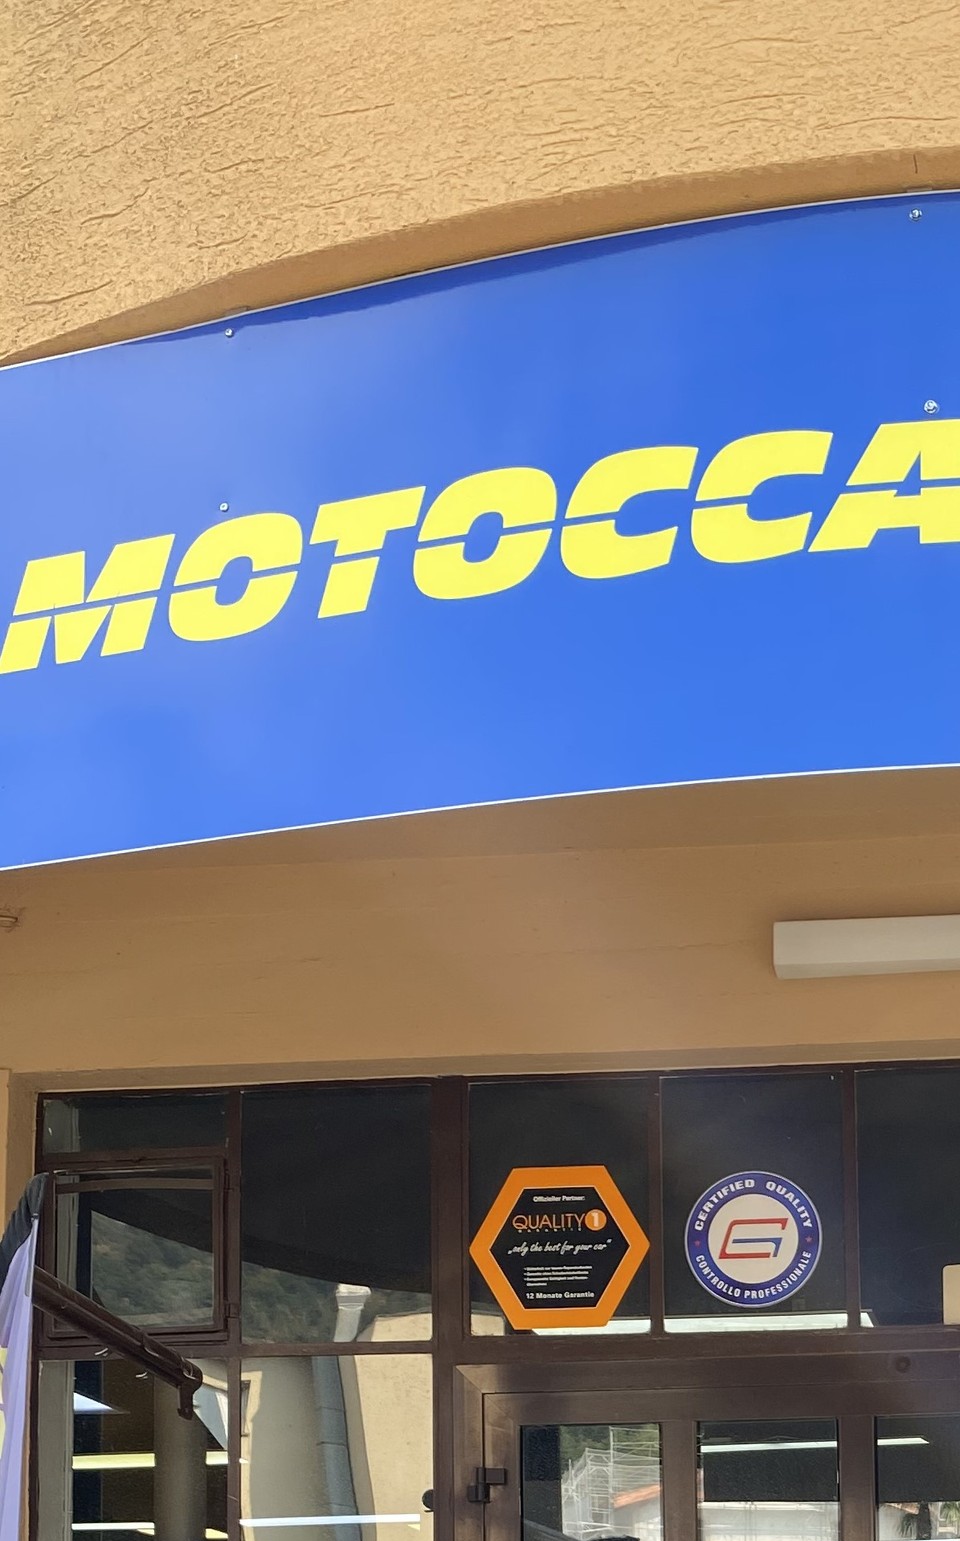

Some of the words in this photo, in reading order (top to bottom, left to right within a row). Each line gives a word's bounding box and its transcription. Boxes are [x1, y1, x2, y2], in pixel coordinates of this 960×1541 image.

[694, 1179, 756, 1231] CERTIFIED
[765, 1181, 813, 1228] QUALITY
[512, 1213, 585, 1230] QUALITY
[530, 1242, 543, 1252] the
[543, 1242, 561, 1252] best
[695, 1255, 741, 1298] CONTROLLO
[744, 1250, 812, 1299] PROFESSIONALE
[526, 1292, 534, 1300] 12
[535, 1291, 563, 1299] Monate
[564, 1290, 595, 1298] Garantie
